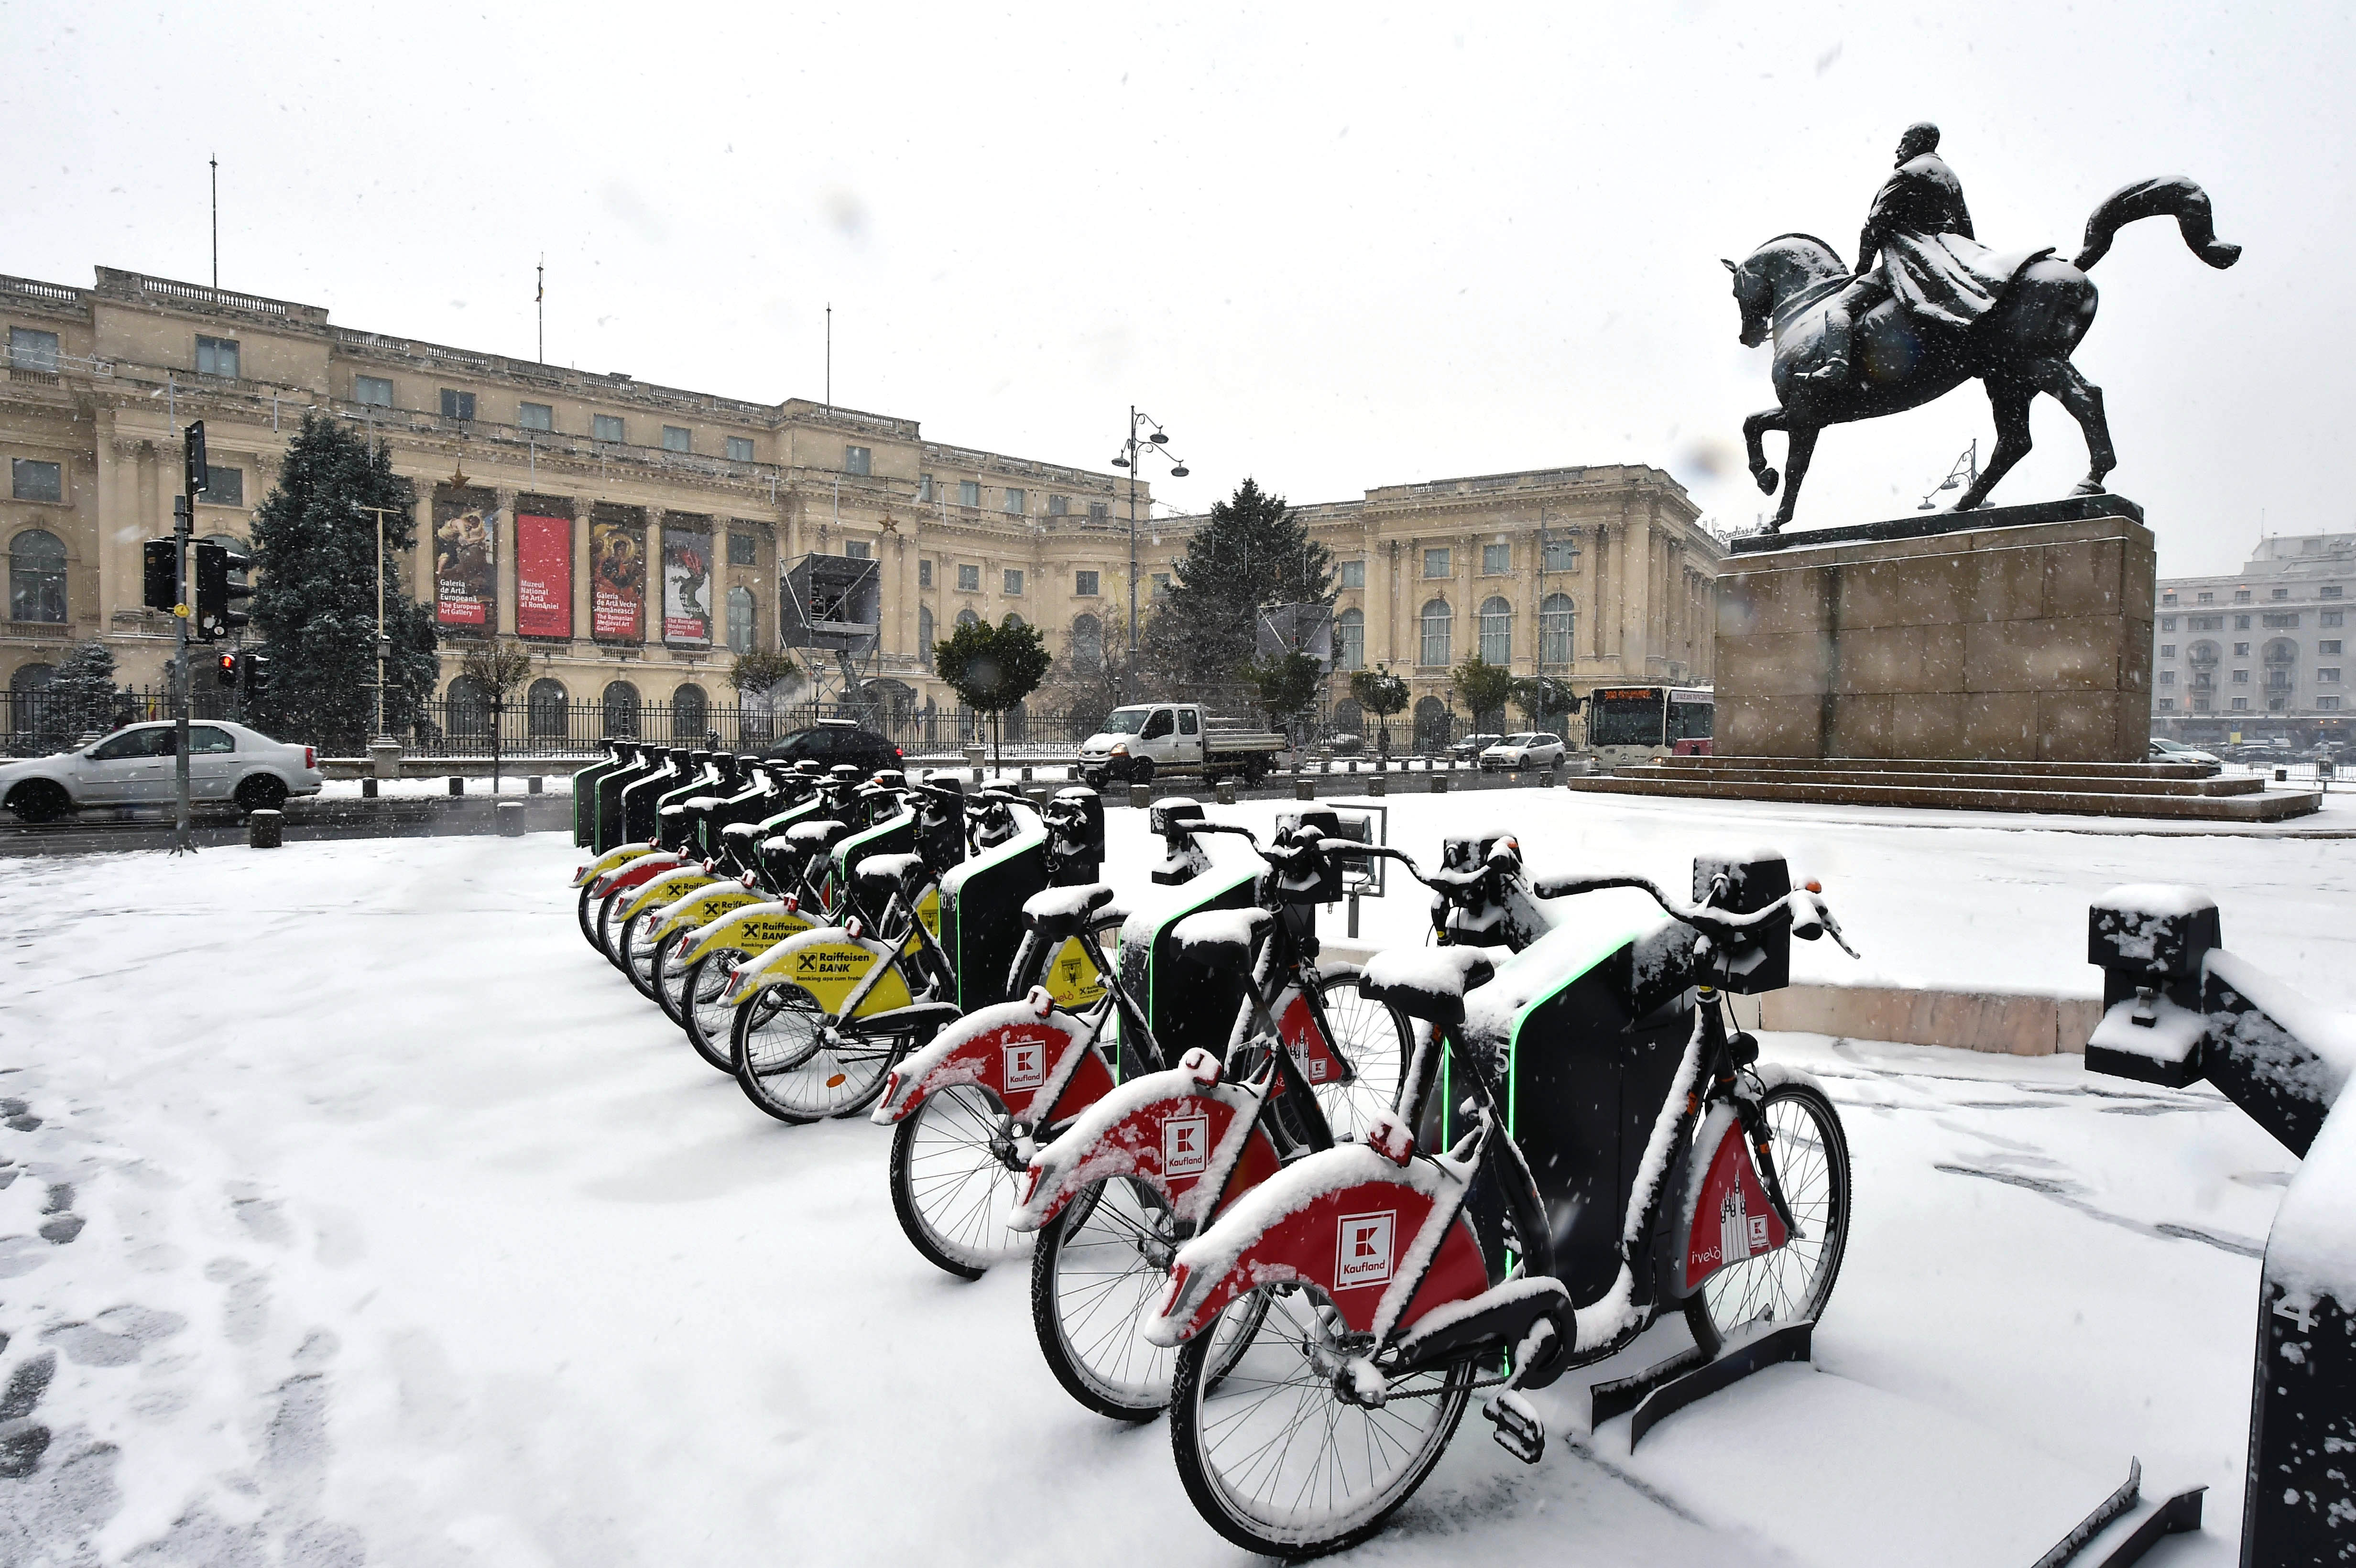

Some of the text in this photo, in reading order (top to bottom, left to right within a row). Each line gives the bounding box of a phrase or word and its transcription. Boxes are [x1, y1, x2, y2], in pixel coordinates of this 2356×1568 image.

[440, 579, 465, 587] Galeria
[521, 580, 544, 588] Muzeul
[440, 593, 477, 602] Europeană
[528, 601, 559, 610] României
[597, 606, 634, 614] Românească
[451, 609, 472, 617] Gallery
[951, 896, 957, 912] 9
[762, 922, 807, 931] Raiffeisen
[819, 952, 870, 962] Raiffeisen
[1142, 949, 1150, 970] 7
[819, 964, 851, 972] BANK
[1493, 1041, 1510, 1073] 5
[1010, 1072, 1040, 1083] Kaufland
[1169, 1155, 1202, 1167] Kaufland
[1343, 1259, 1385, 1274] Kaufland
